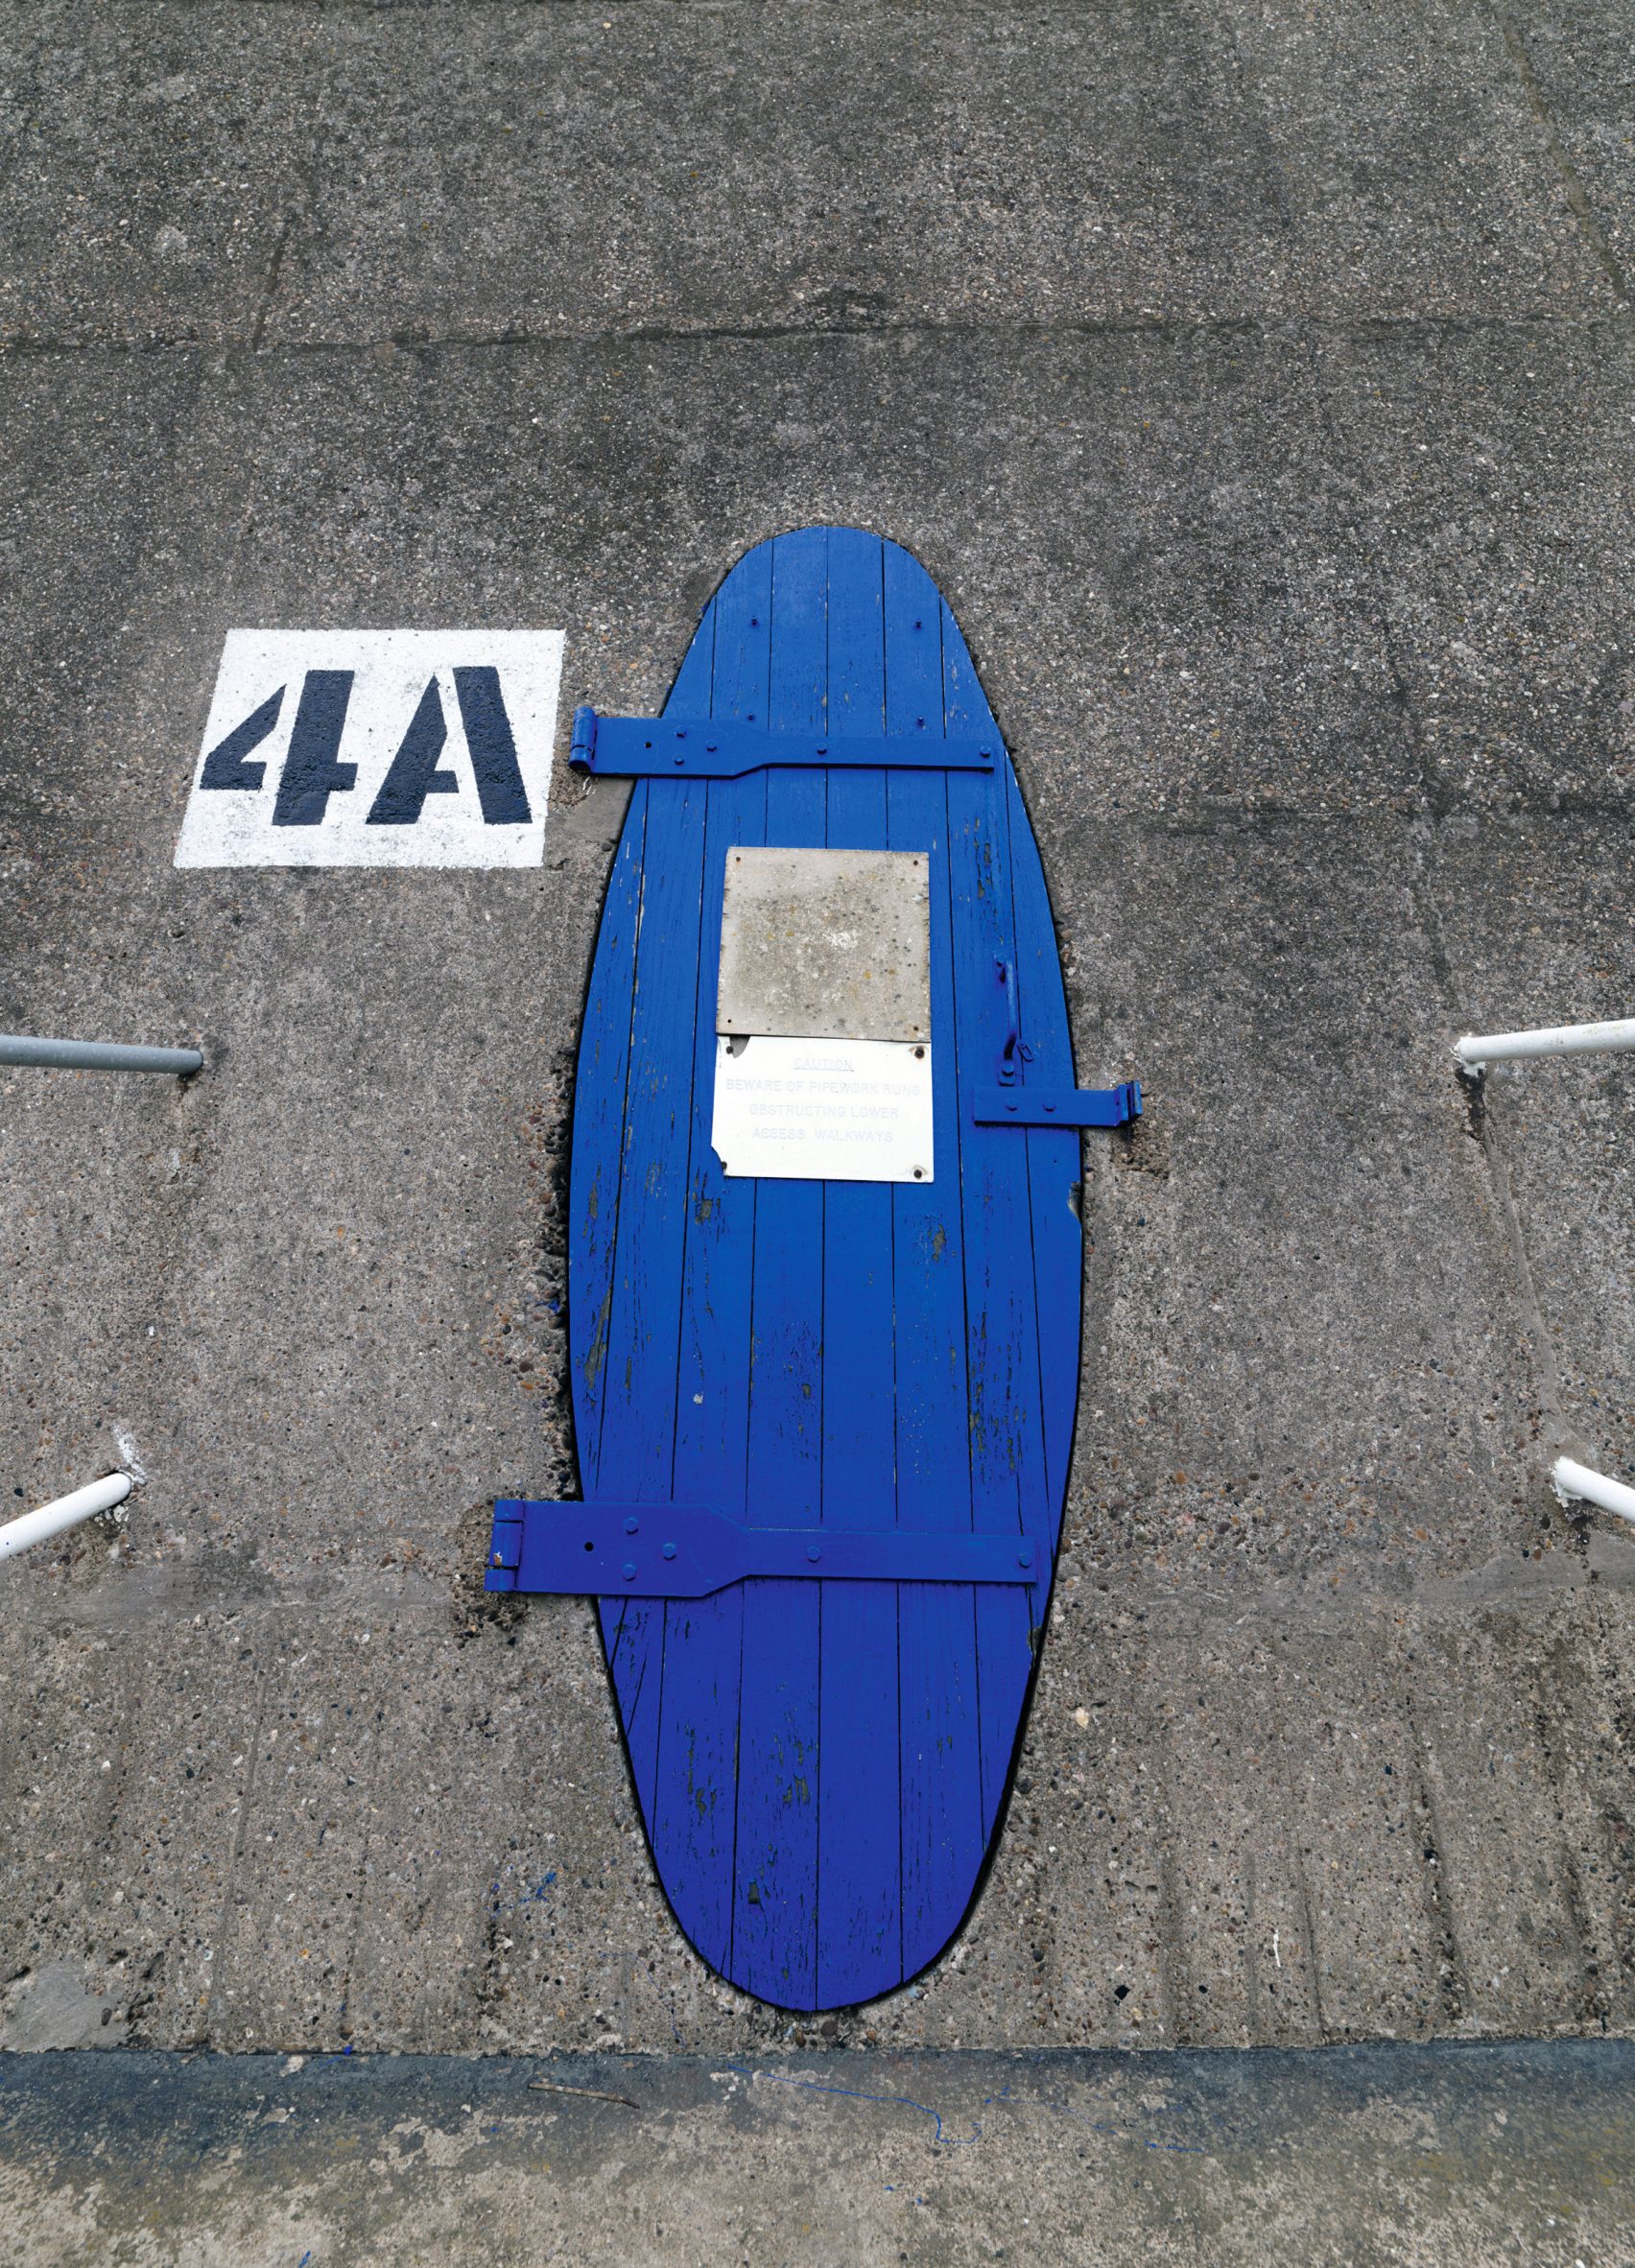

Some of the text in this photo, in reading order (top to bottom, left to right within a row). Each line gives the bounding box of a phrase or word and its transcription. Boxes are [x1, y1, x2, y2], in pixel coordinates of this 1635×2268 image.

[200, 666, 533, 826] 4A
[794, 1058, 853, 1070] CAUTION
[726, 1079, 920, 1096] BEWARE OF PIPEWORK RUNS
[749, 1104, 898, 1119] OBSTRUCTING LOWER
[752, 1128, 892, 1143] ACCESS WALKWAYS
